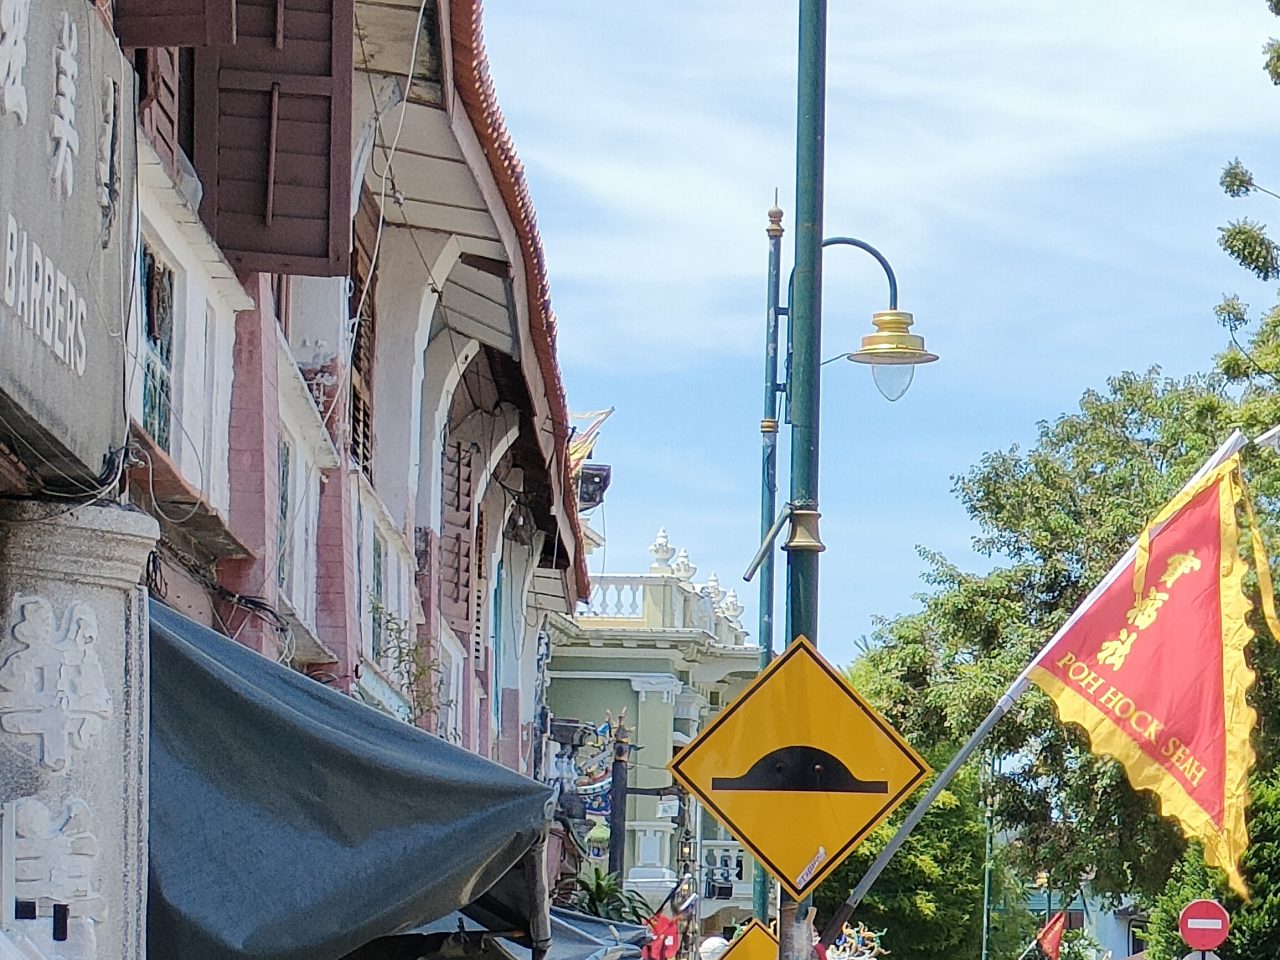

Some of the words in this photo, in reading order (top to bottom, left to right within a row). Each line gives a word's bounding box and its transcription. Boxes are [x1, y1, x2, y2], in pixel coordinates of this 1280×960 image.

[4, 212, 87, 377] BARBERS
[1056, 652, 1105, 695] POH
[1099, 686, 1165, 745] HOCK
[1161, 737, 1207, 788] SEAH
